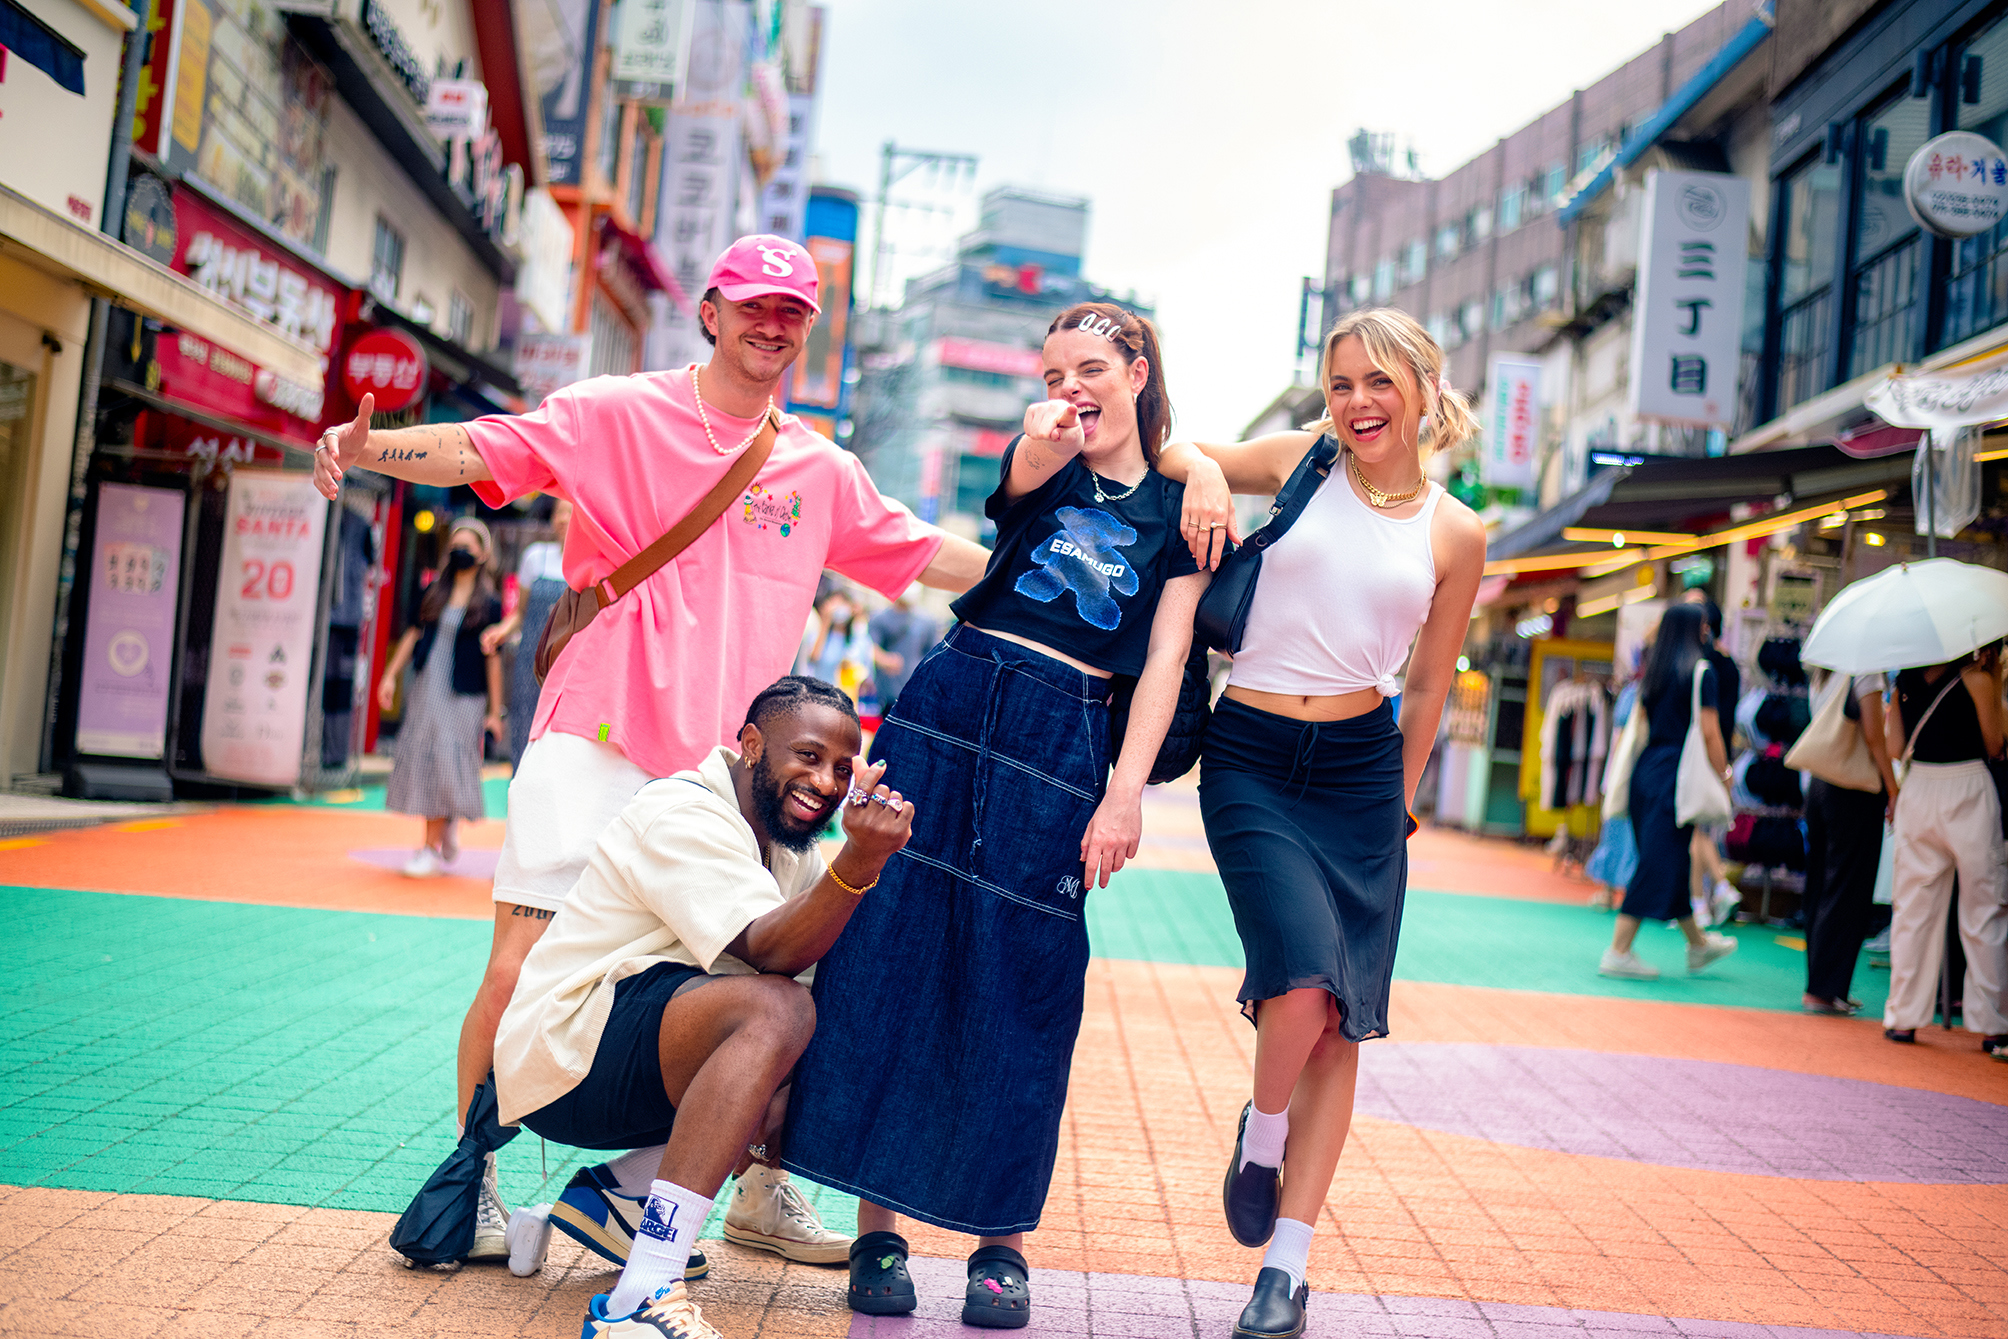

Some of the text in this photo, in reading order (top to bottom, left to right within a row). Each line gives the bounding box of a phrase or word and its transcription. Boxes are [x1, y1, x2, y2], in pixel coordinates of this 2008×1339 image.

[757, 245, 797, 277] S
[1671, 242, 1715, 394] 三丁目
[349, 353, 419, 389] 부동산
[1049, 539, 1126, 578] ESAMUGO
[241, 557, 296, 602] 20
